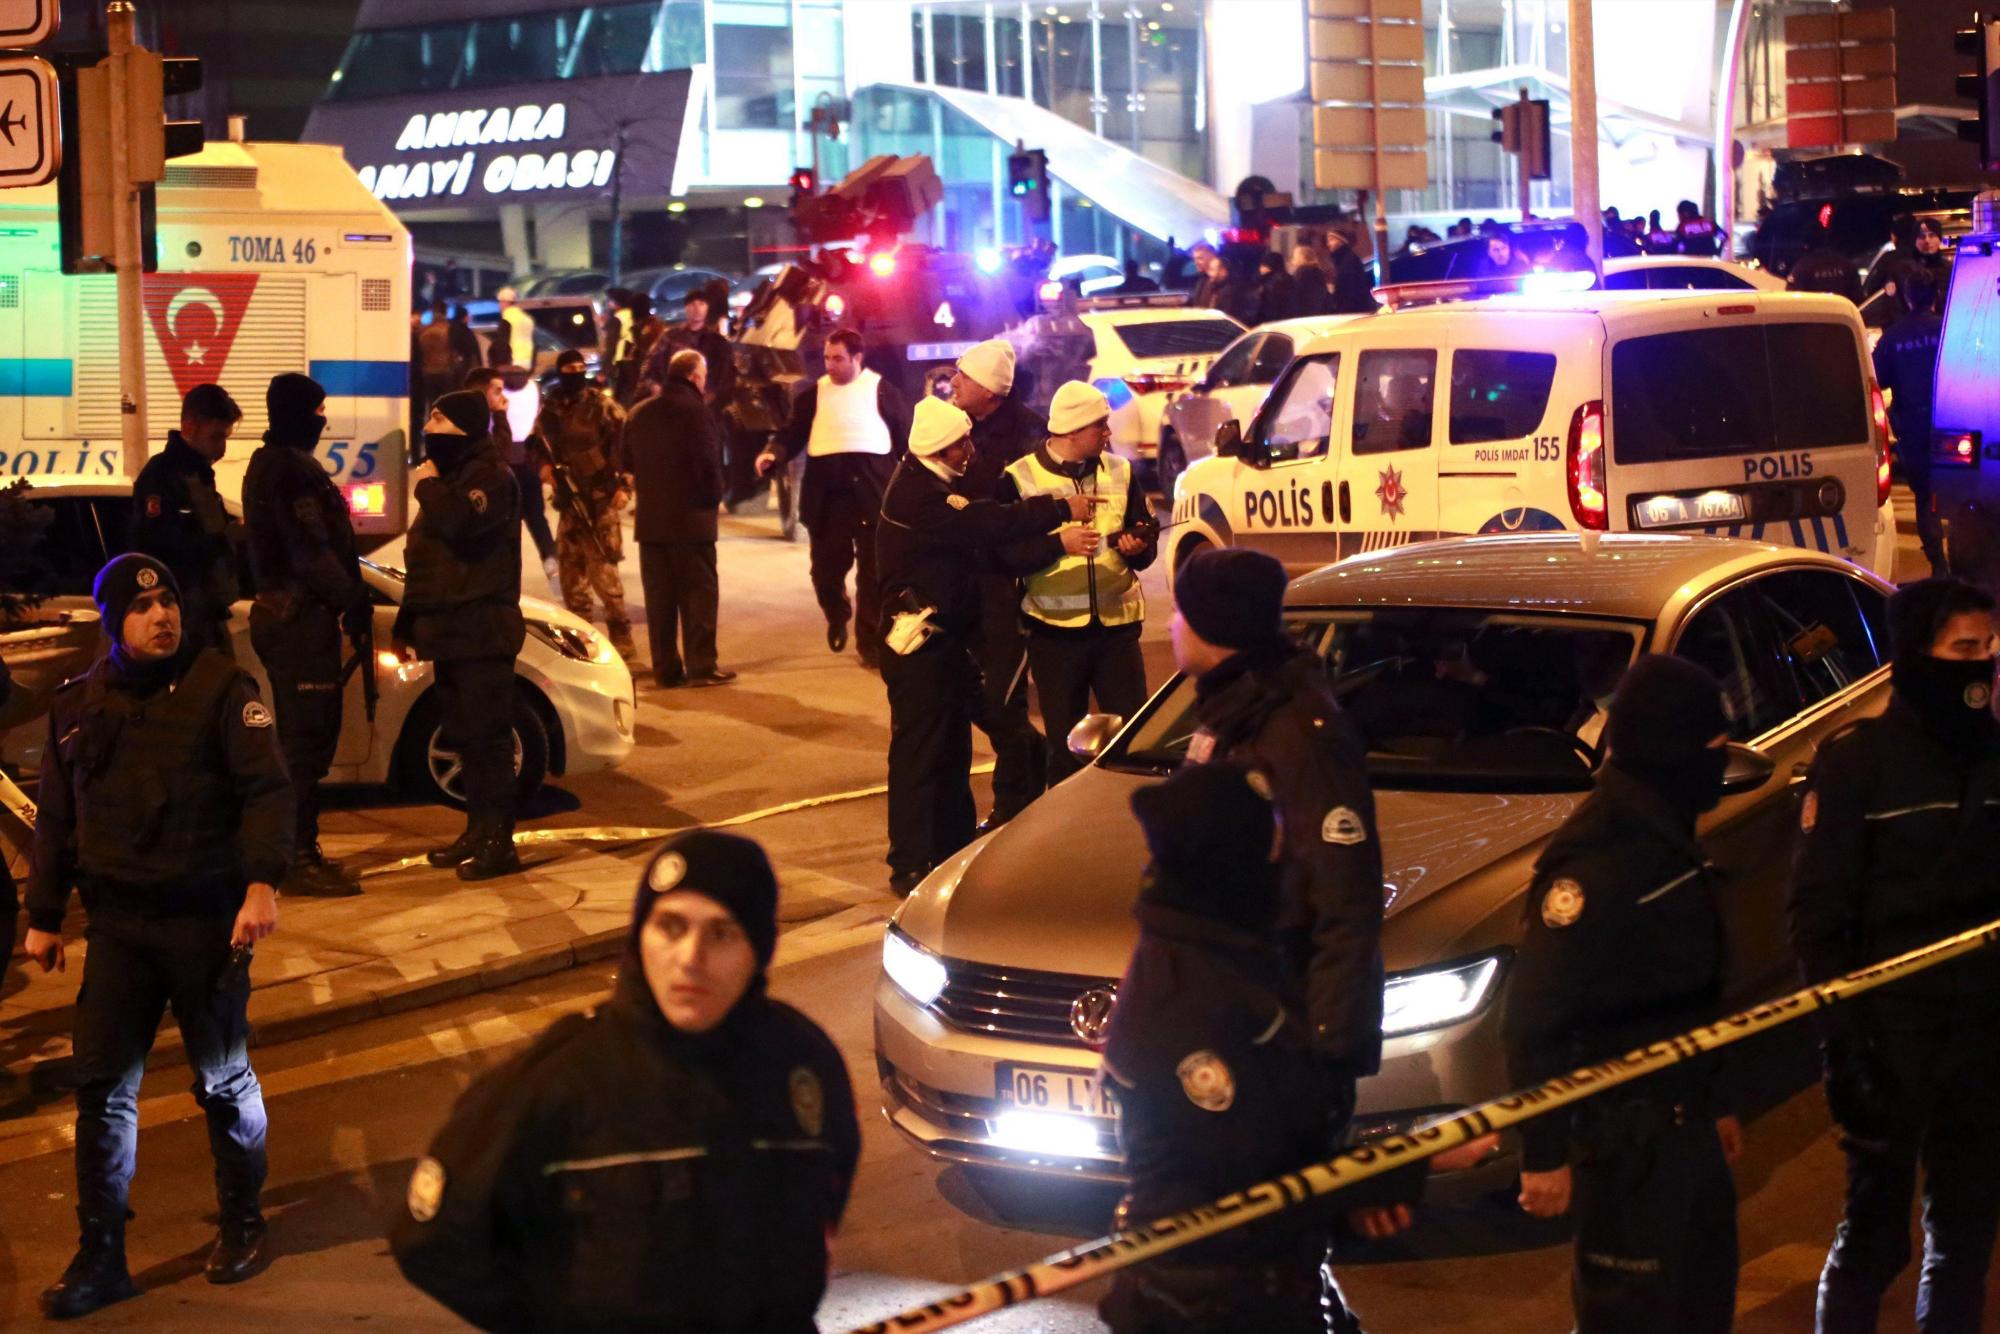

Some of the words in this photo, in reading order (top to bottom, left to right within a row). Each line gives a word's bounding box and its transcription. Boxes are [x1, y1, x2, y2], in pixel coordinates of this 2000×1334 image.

[395, 103, 565, 150] ANKARA
[483, 149, 616, 193] ODASI
[228, 236, 286, 263] TOMA
[293, 238, 316, 264] 46
[933, 301, 956, 328] 4
[1533, 436, 1560, 461] 155
[1016, 1072, 1049, 1107] 06
